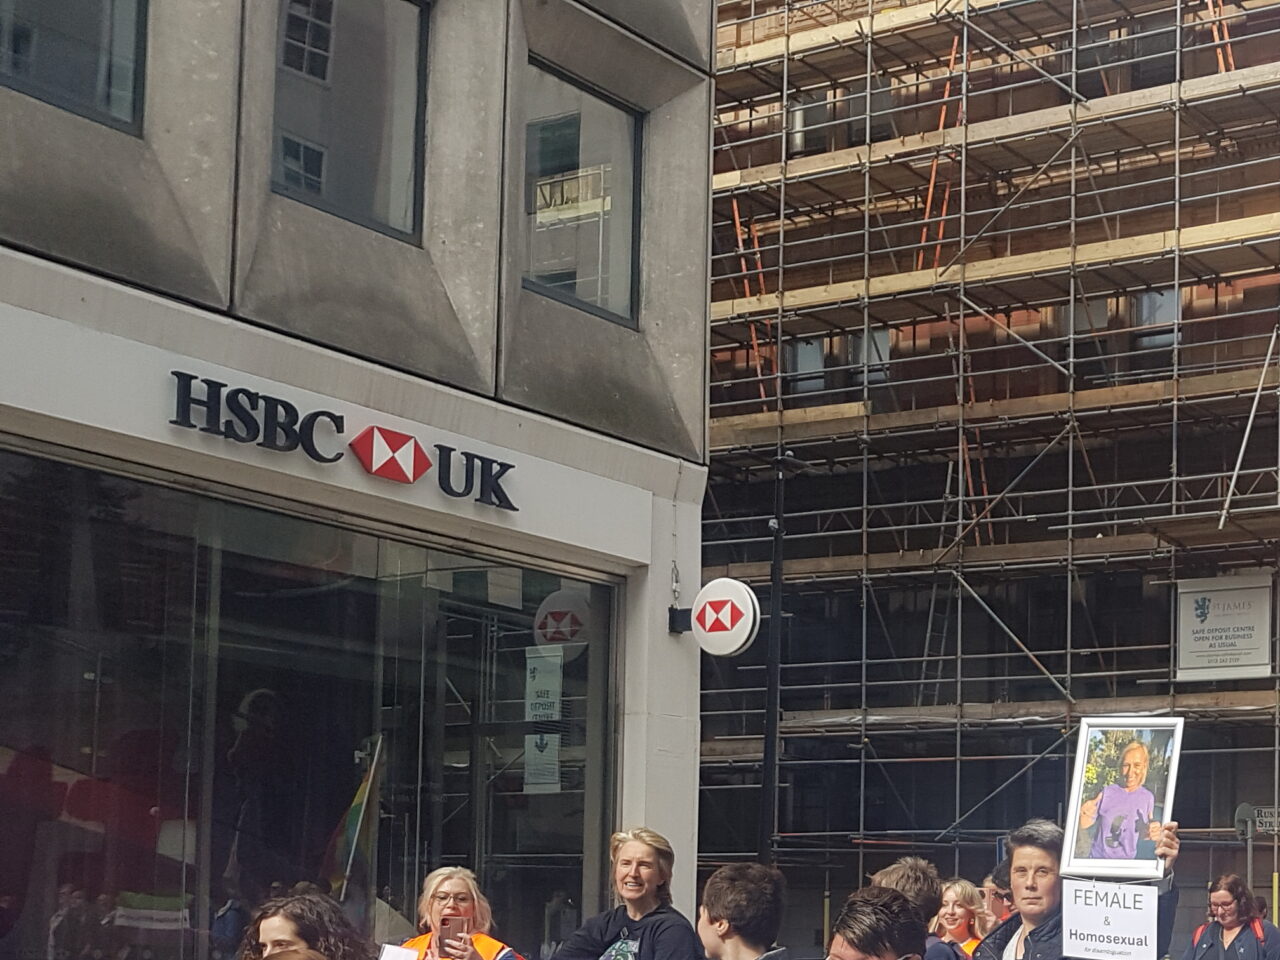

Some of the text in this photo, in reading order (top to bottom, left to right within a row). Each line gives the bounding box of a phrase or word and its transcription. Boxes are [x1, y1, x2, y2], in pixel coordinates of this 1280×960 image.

[168, 370, 520, 511] HSBC UK
[1224, 632, 1253, 640] BUSINESS
[1232, 625, 1255, 633] CENTRE
[1073, 888, 1144, 911] FEMALE
[1103, 916, 1111, 926] &
[1069, 929, 1149, 947] Homosexual
